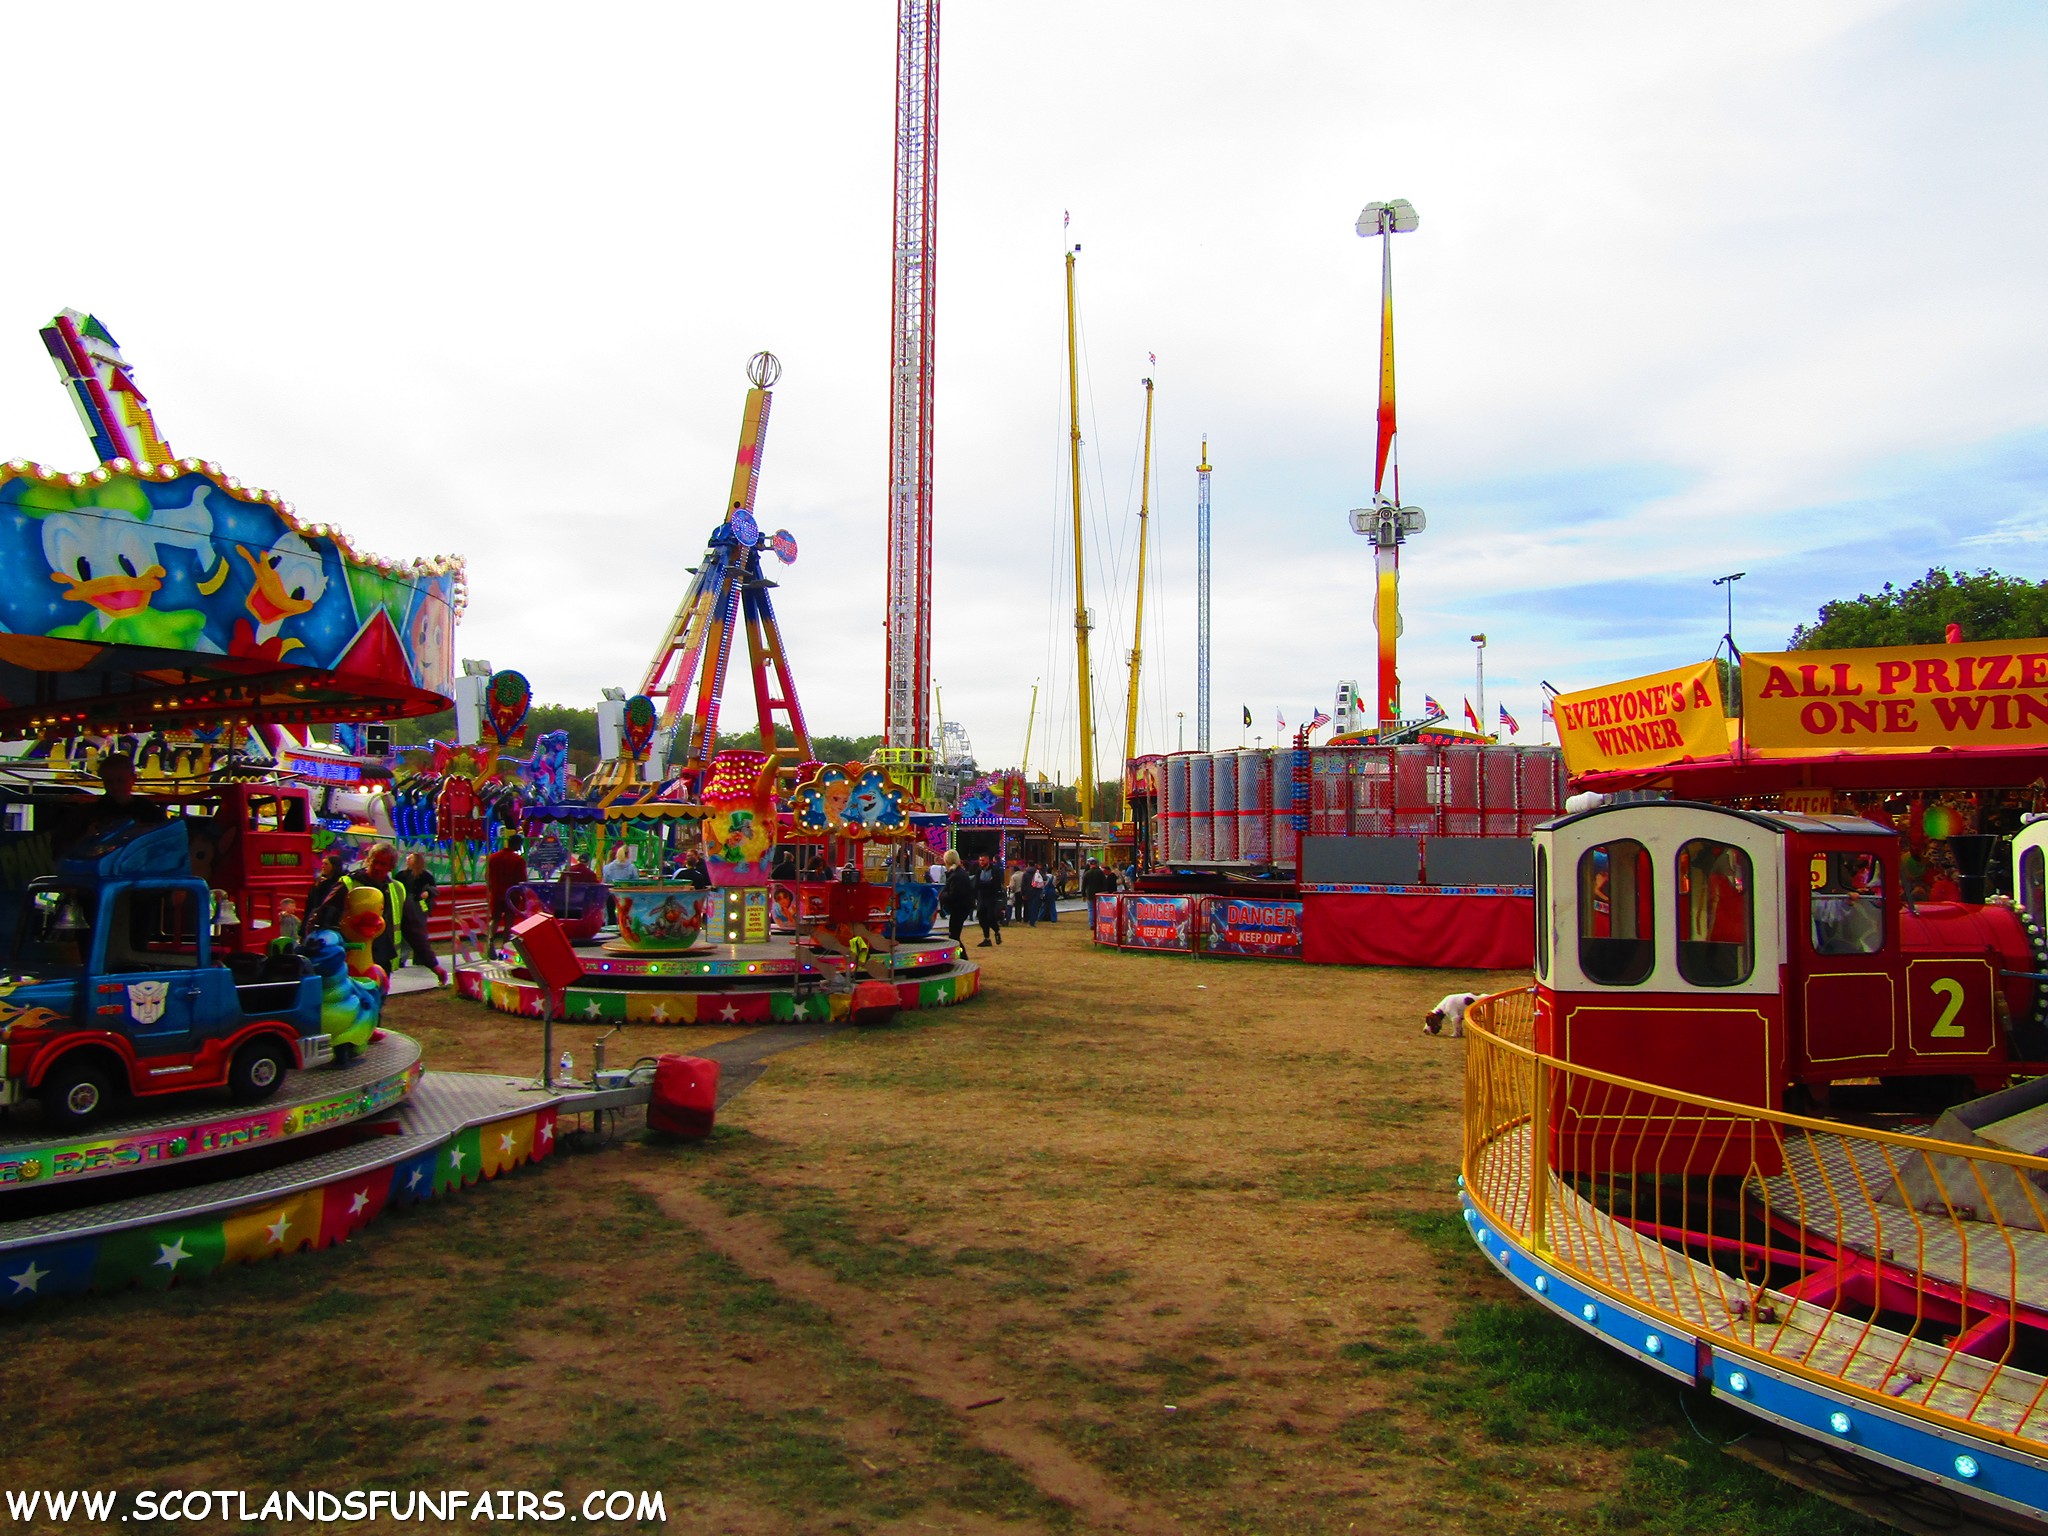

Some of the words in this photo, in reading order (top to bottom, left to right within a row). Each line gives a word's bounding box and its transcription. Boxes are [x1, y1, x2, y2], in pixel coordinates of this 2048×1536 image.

[1759, 663, 1863, 699] ALL
[1876, 652, 2048, 695] PRIZE
[1561, 681, 1686, 731] EVERYONE'S
[1692, 677, 1712, 710] A
[1800, 698, 1919, 735] ONE
[1592, 717, 1685, 757] WINNER
[1785, 796, 1830, 813] CATCH
[1136, 902, 1177, 922] DANGER
[1227, 904, 1297, 928] DANGER
[1143, 926, 1156, 938] KEEP
[1157, 927, 1168, 938] OUT
[1239, 931, 1263, 944] KEEP
[1264, 932, 1282, 945] OUT
[1930, 977, 1965, 1038] 2
[53, 1138, 166, 1178] BEST
[202, 1118, 271, 1150] ONE
